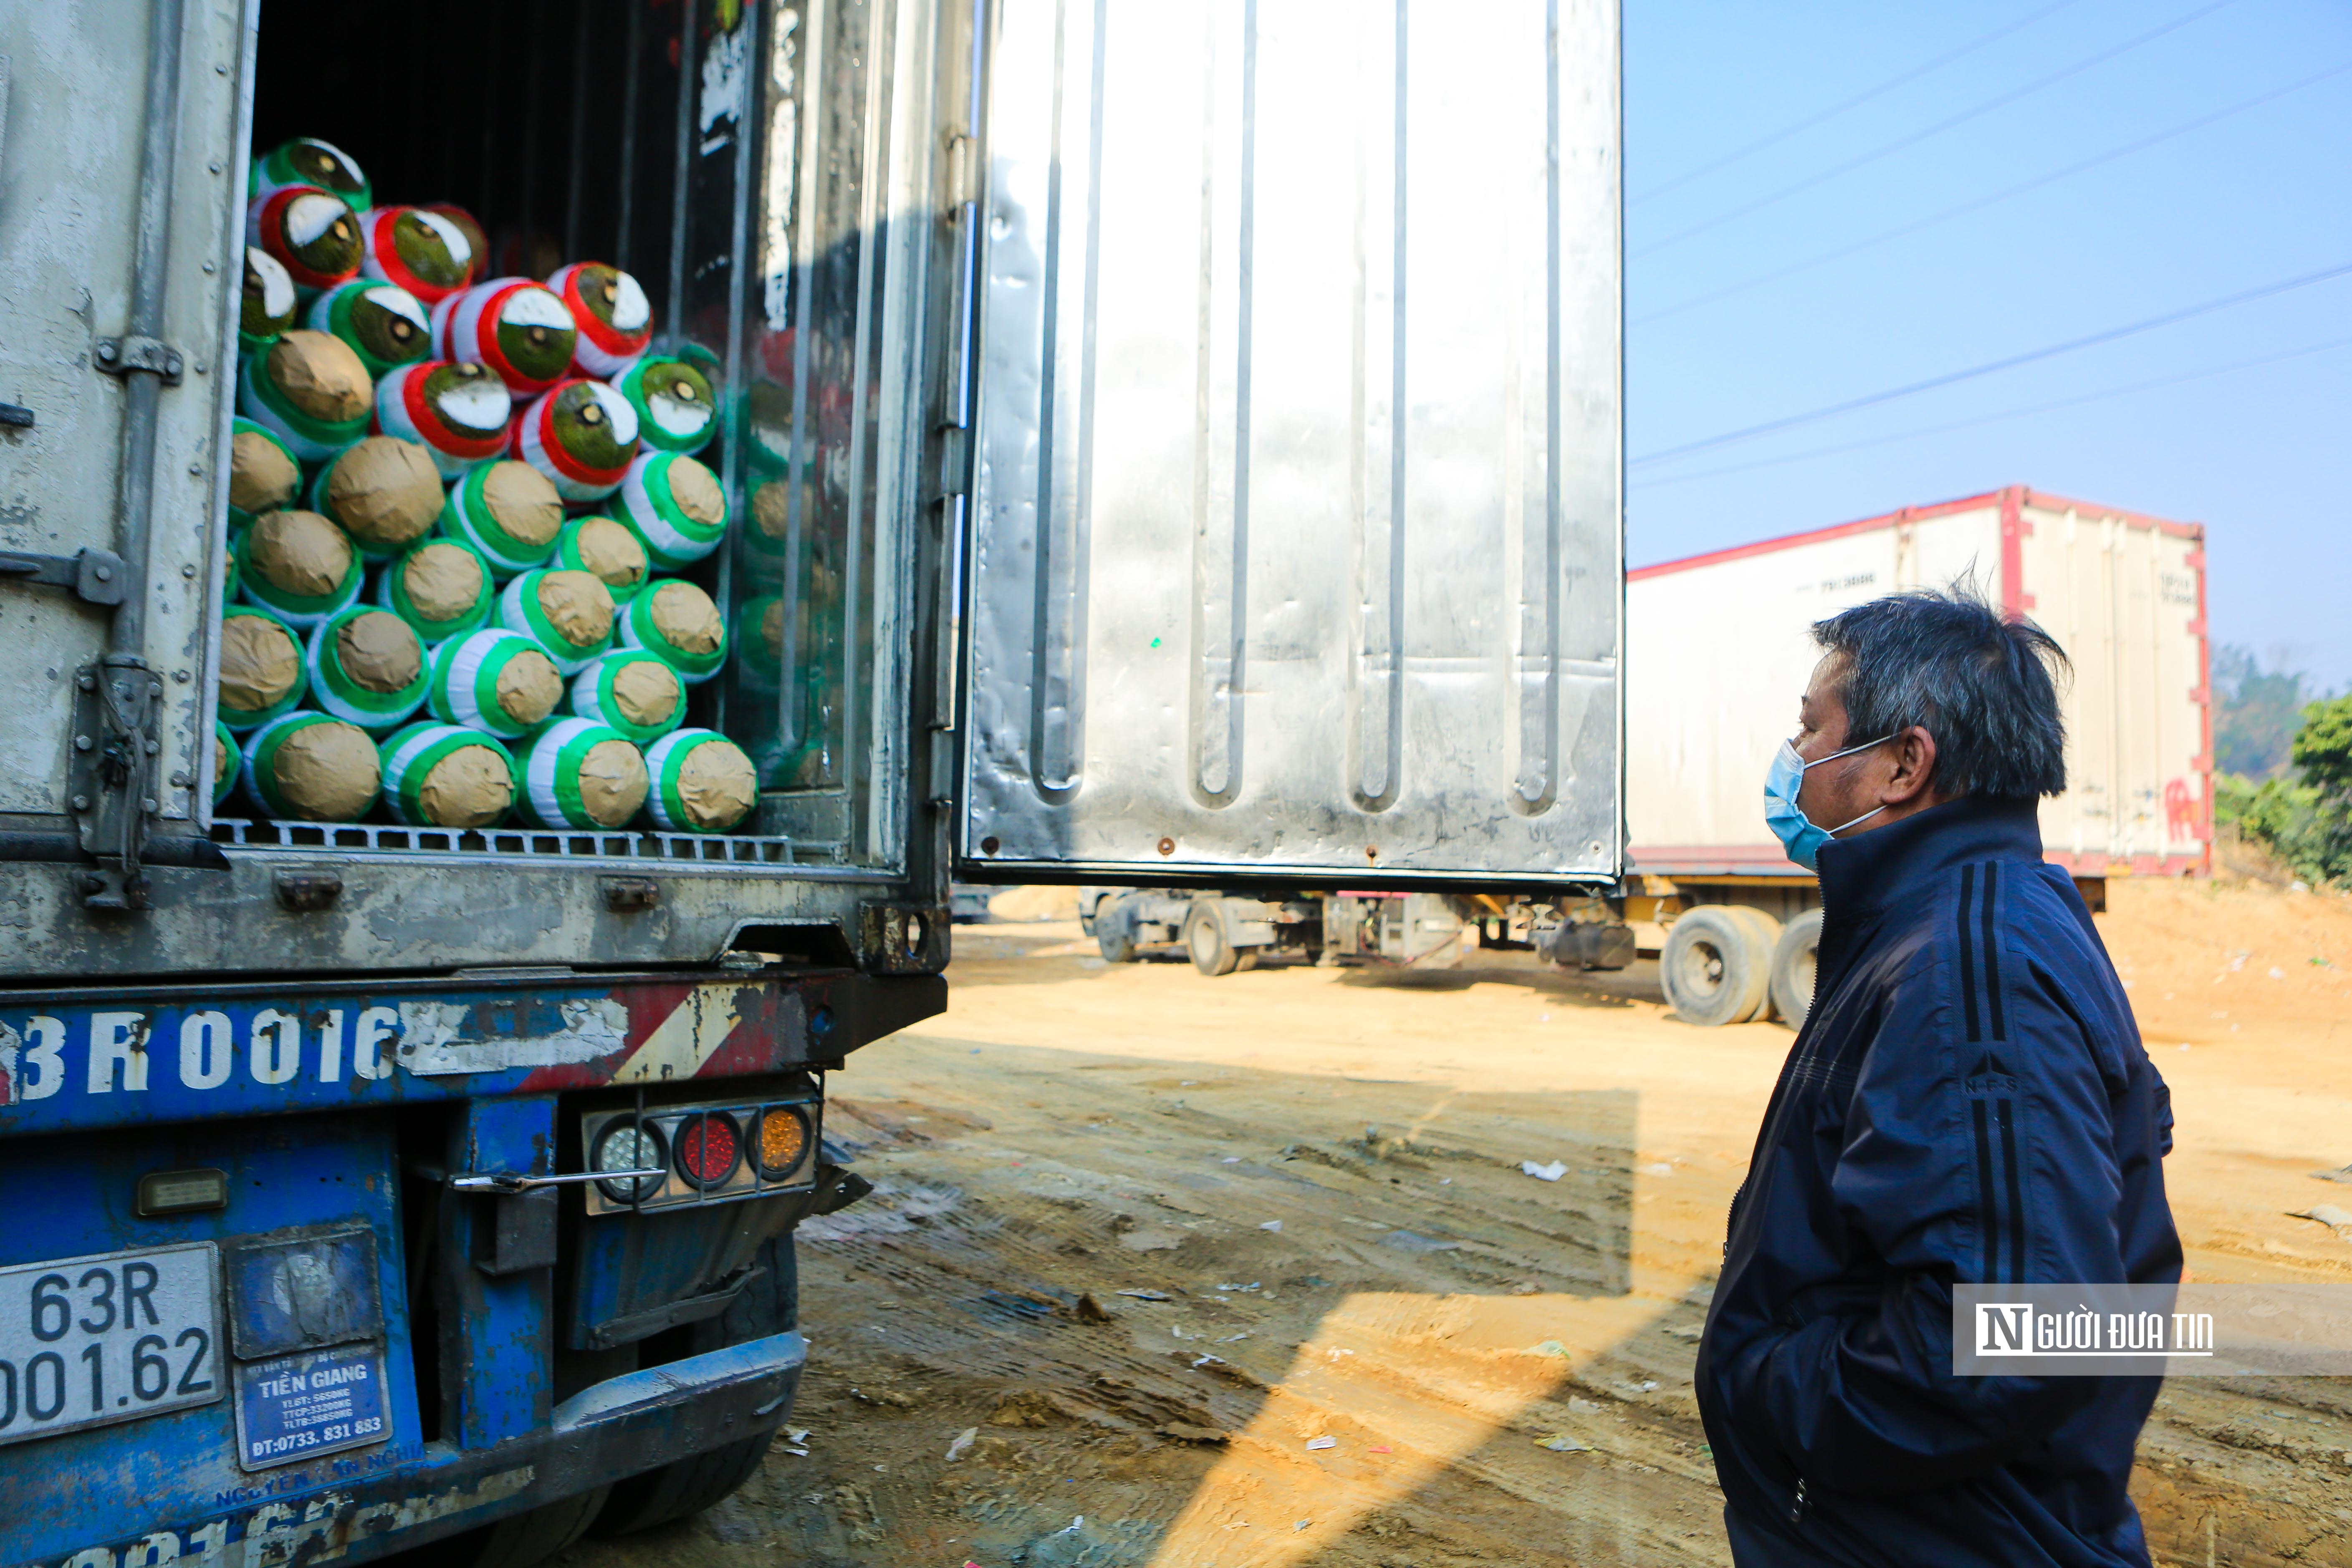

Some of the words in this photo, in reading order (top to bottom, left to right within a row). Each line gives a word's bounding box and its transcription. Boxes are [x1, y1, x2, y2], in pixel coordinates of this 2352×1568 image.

[31, 1261, 159, 1342] 63R
[258, 1371, 306, 1398] TIỀN
[311, 1364, 368, 1389] GIANG
[323, 1423, 351, 1441] 831
[354, 1417, 381, 1434] 883
